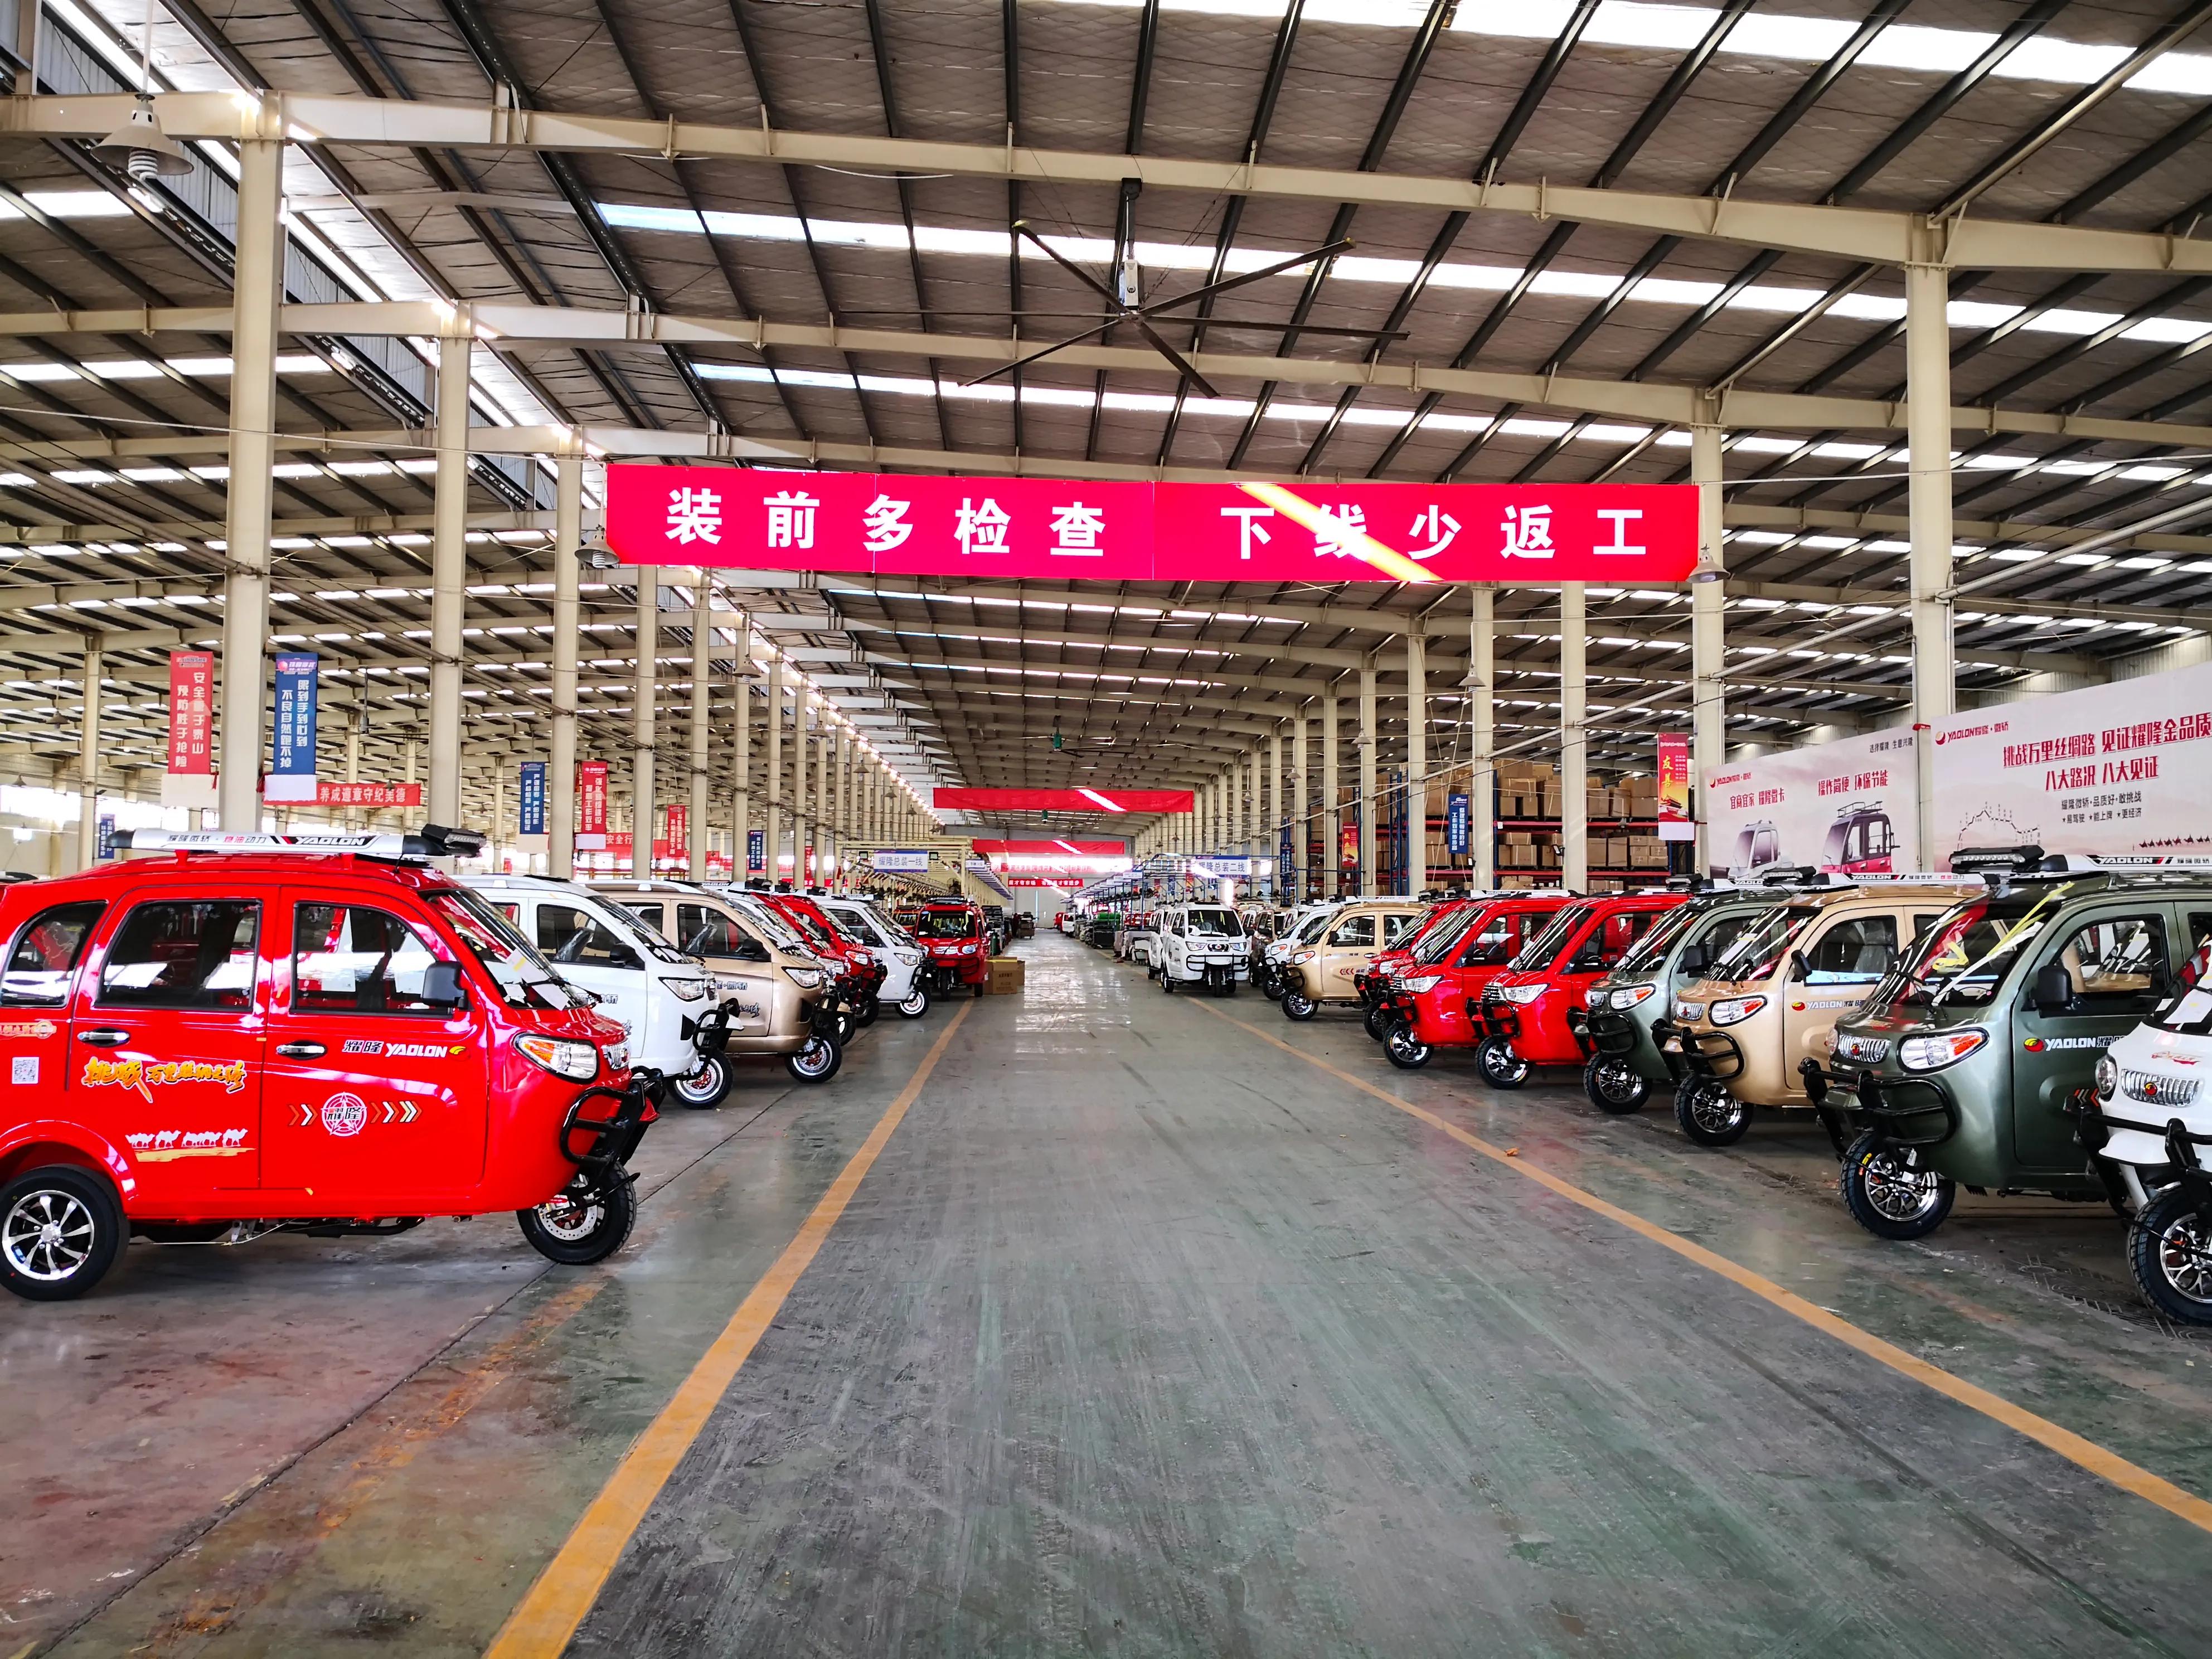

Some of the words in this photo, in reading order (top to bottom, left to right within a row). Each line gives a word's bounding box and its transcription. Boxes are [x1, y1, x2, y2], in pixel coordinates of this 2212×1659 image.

[665, 487, 1106, 557] 装前多检查
[1220, 503, 1647, 560] 下线少返工
[192, 672, 206, 754] 安全重于泰山
[296, 680, 309, 747] 眼到手到心到
[175, 685, 189, 768] 预防胜于抢险
[280, 690, 293, 768] 不良自然跑不掉
[1947, 727, 1975, 743] YAOLON
[1869, 741, 1890, 753] 选择耀隆
[1892, 736, 1913, 749] 生意兴隆
[2003, 733, 2096, 767] 挑战万里丝绸路
[2102, 711, 2212, 753] 见证耀隆金品质
[2045, 764, 2096, 792] 八大路况
[2102, 755, 2160, 784] 八大见证
[1818, 776, 1850, 797] 操作简便
[1854, 769, 1889, 791] 环保节能
[320, 786, 406, 803] 养成遵章守纪美德
[1730, 792, 1755, 809] 宜商宜家
[2121, 807, 2142, 819] 更经济
[295, 836, 367, 845] YAOLON
[879, 856, 923, 866] 耀隆总装一线
[1806, 1001, 1842, 1011] YAOLON
[342, 1040, 385, 1054] 耀隆
[384, 1042, 448, 1058] YAOLON
[2044, 1037, 2097, 1051] YAOLON
[327, 1107, 361, 1120] 耀隆
